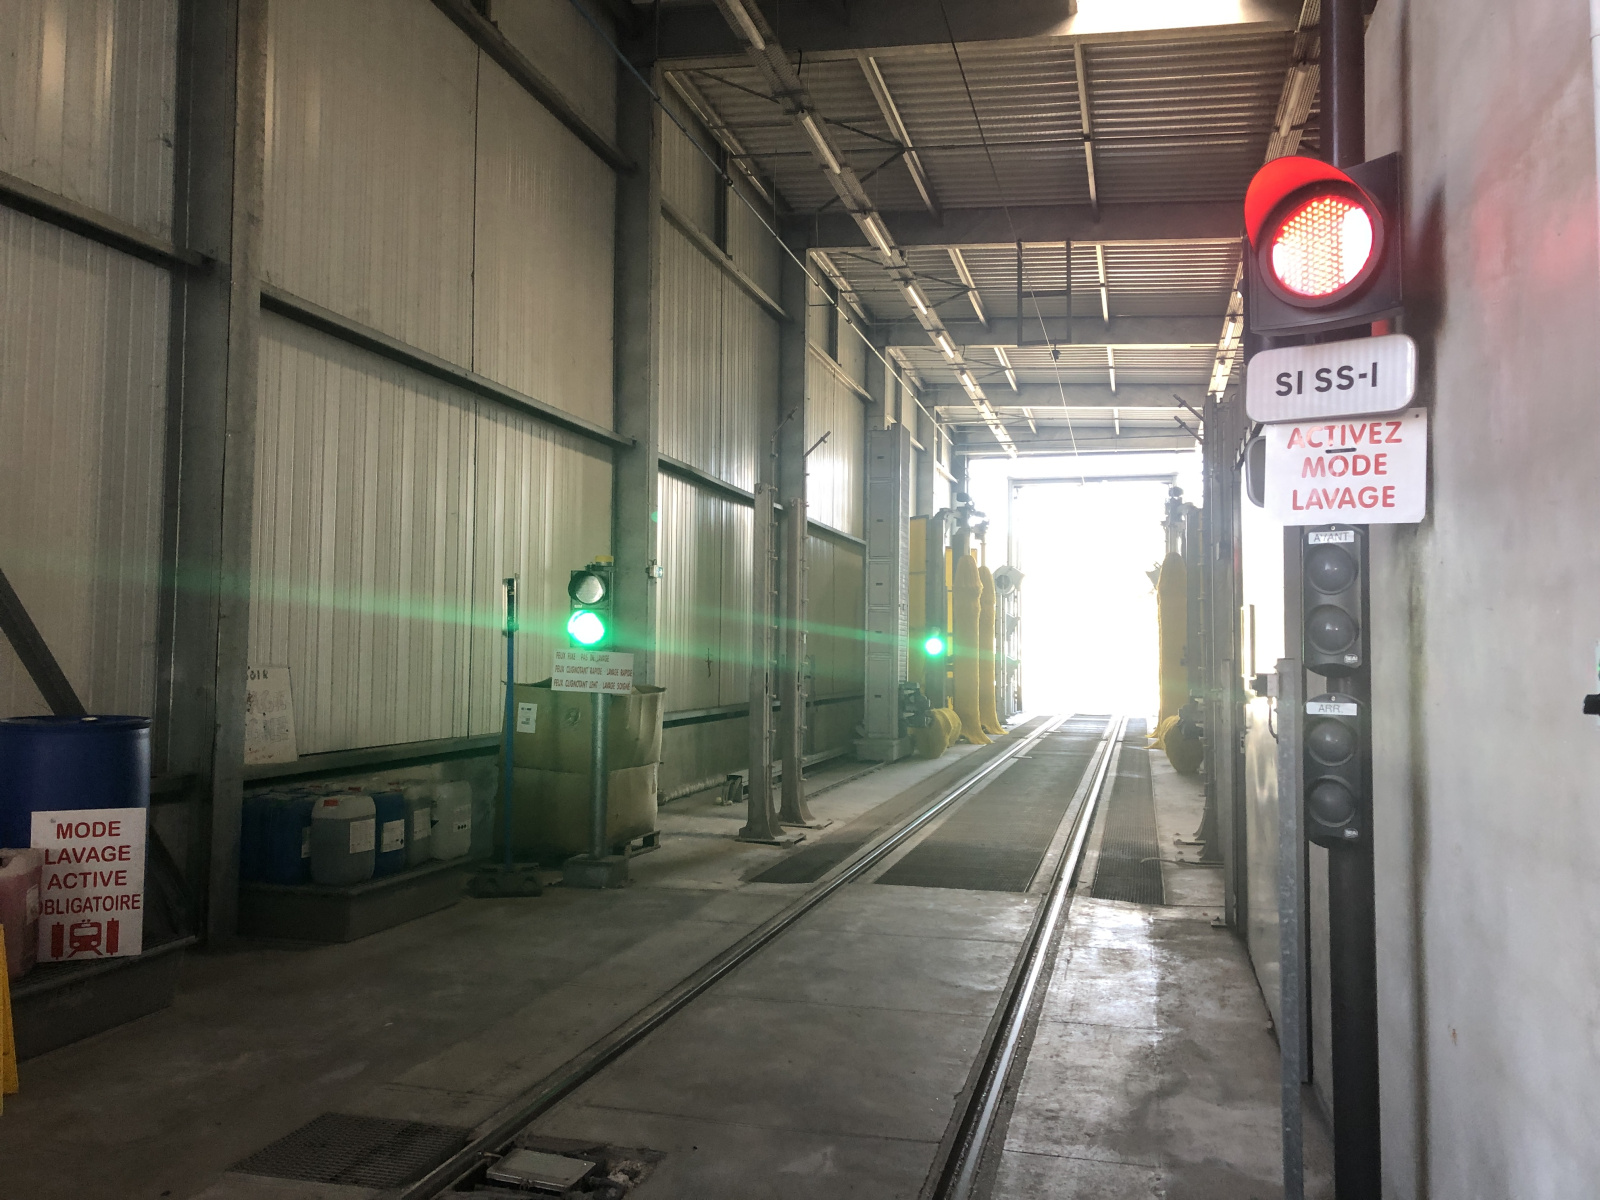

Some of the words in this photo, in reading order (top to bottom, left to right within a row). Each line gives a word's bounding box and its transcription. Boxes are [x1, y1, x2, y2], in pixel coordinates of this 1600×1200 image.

[1275, 370, 1303, 397] SI
[1286, 421, 1403, 450] ACTIVEZ
[1301, 453, 1388, 479] MODE
[1292, 485, 1396, 511] LAVAGE
[56, 820, 122, 839] MODE
[44, 845, 132, 865] LAVAGE
[47, 870, 128, 890] ACTIVE
